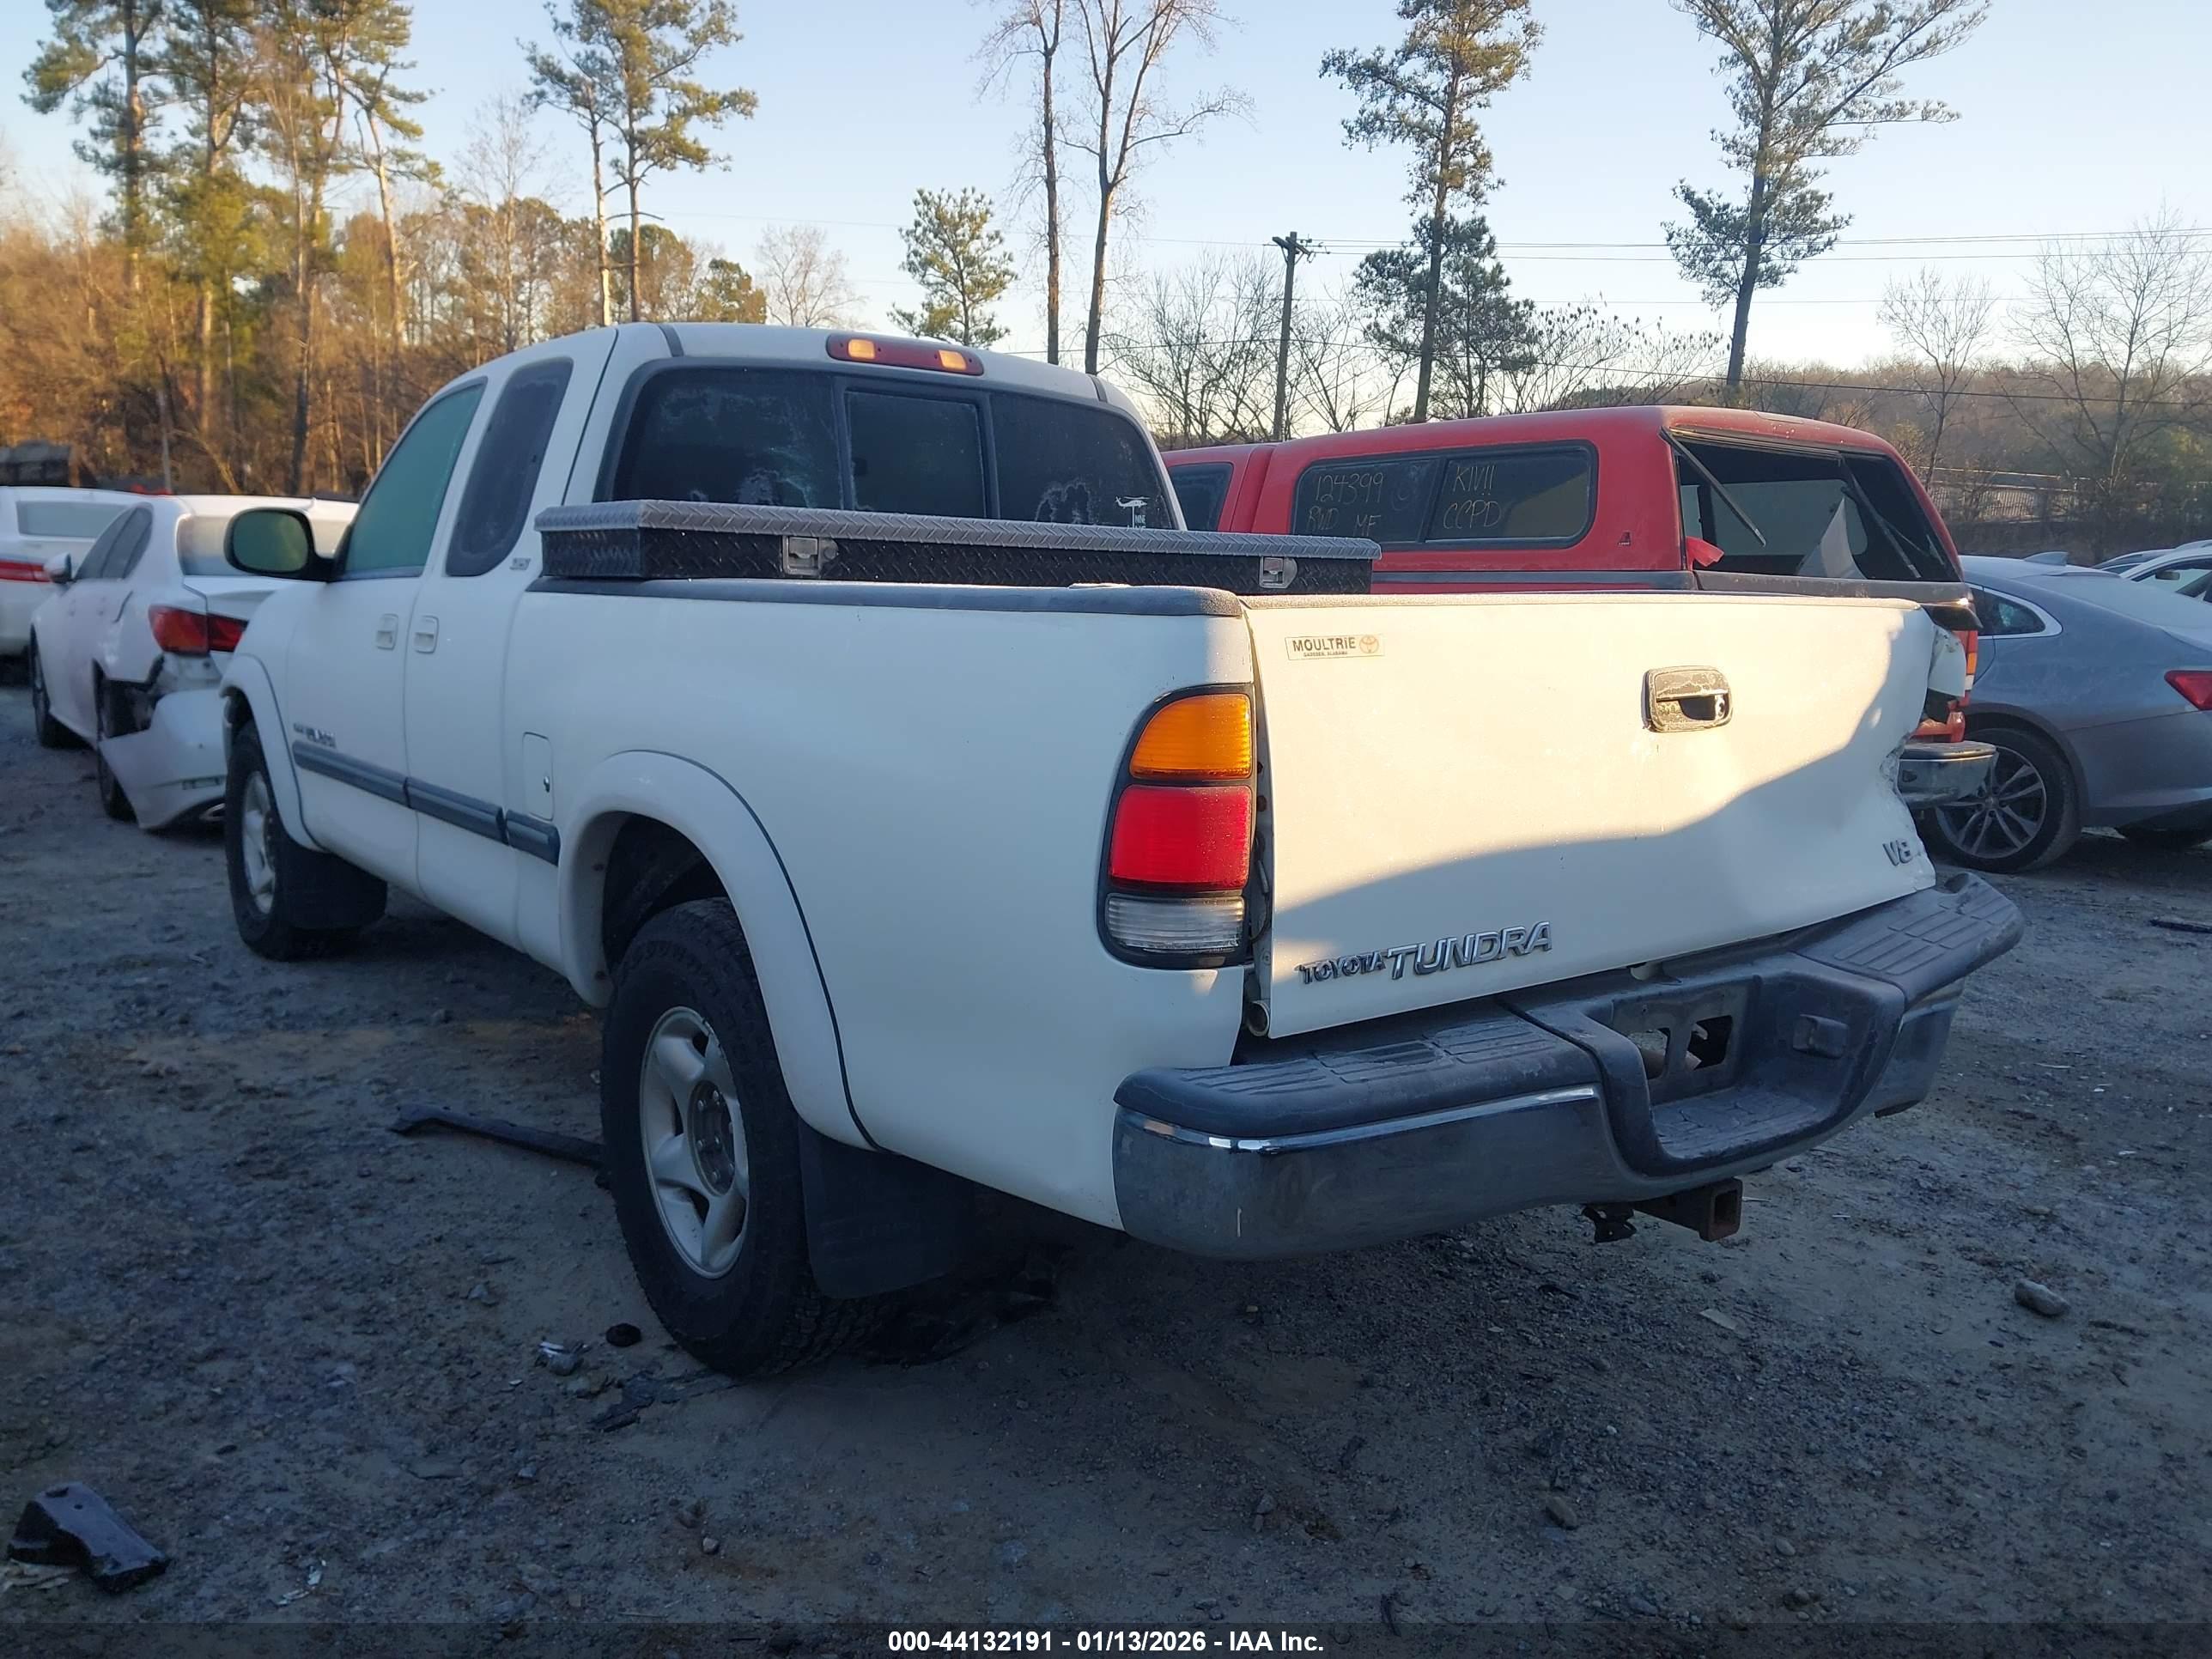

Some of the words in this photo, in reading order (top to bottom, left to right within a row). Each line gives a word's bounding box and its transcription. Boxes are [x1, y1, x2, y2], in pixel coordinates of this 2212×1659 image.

[1316, 472, 1384, 505] 124399
[1292, 637, 1357, 652] MOULTRIE
[1882, 839, 1914, 866] V8
[1294, 951, 1387, 984] TOYOTA
[1387, 921, 1553, 980] TUNDRA
